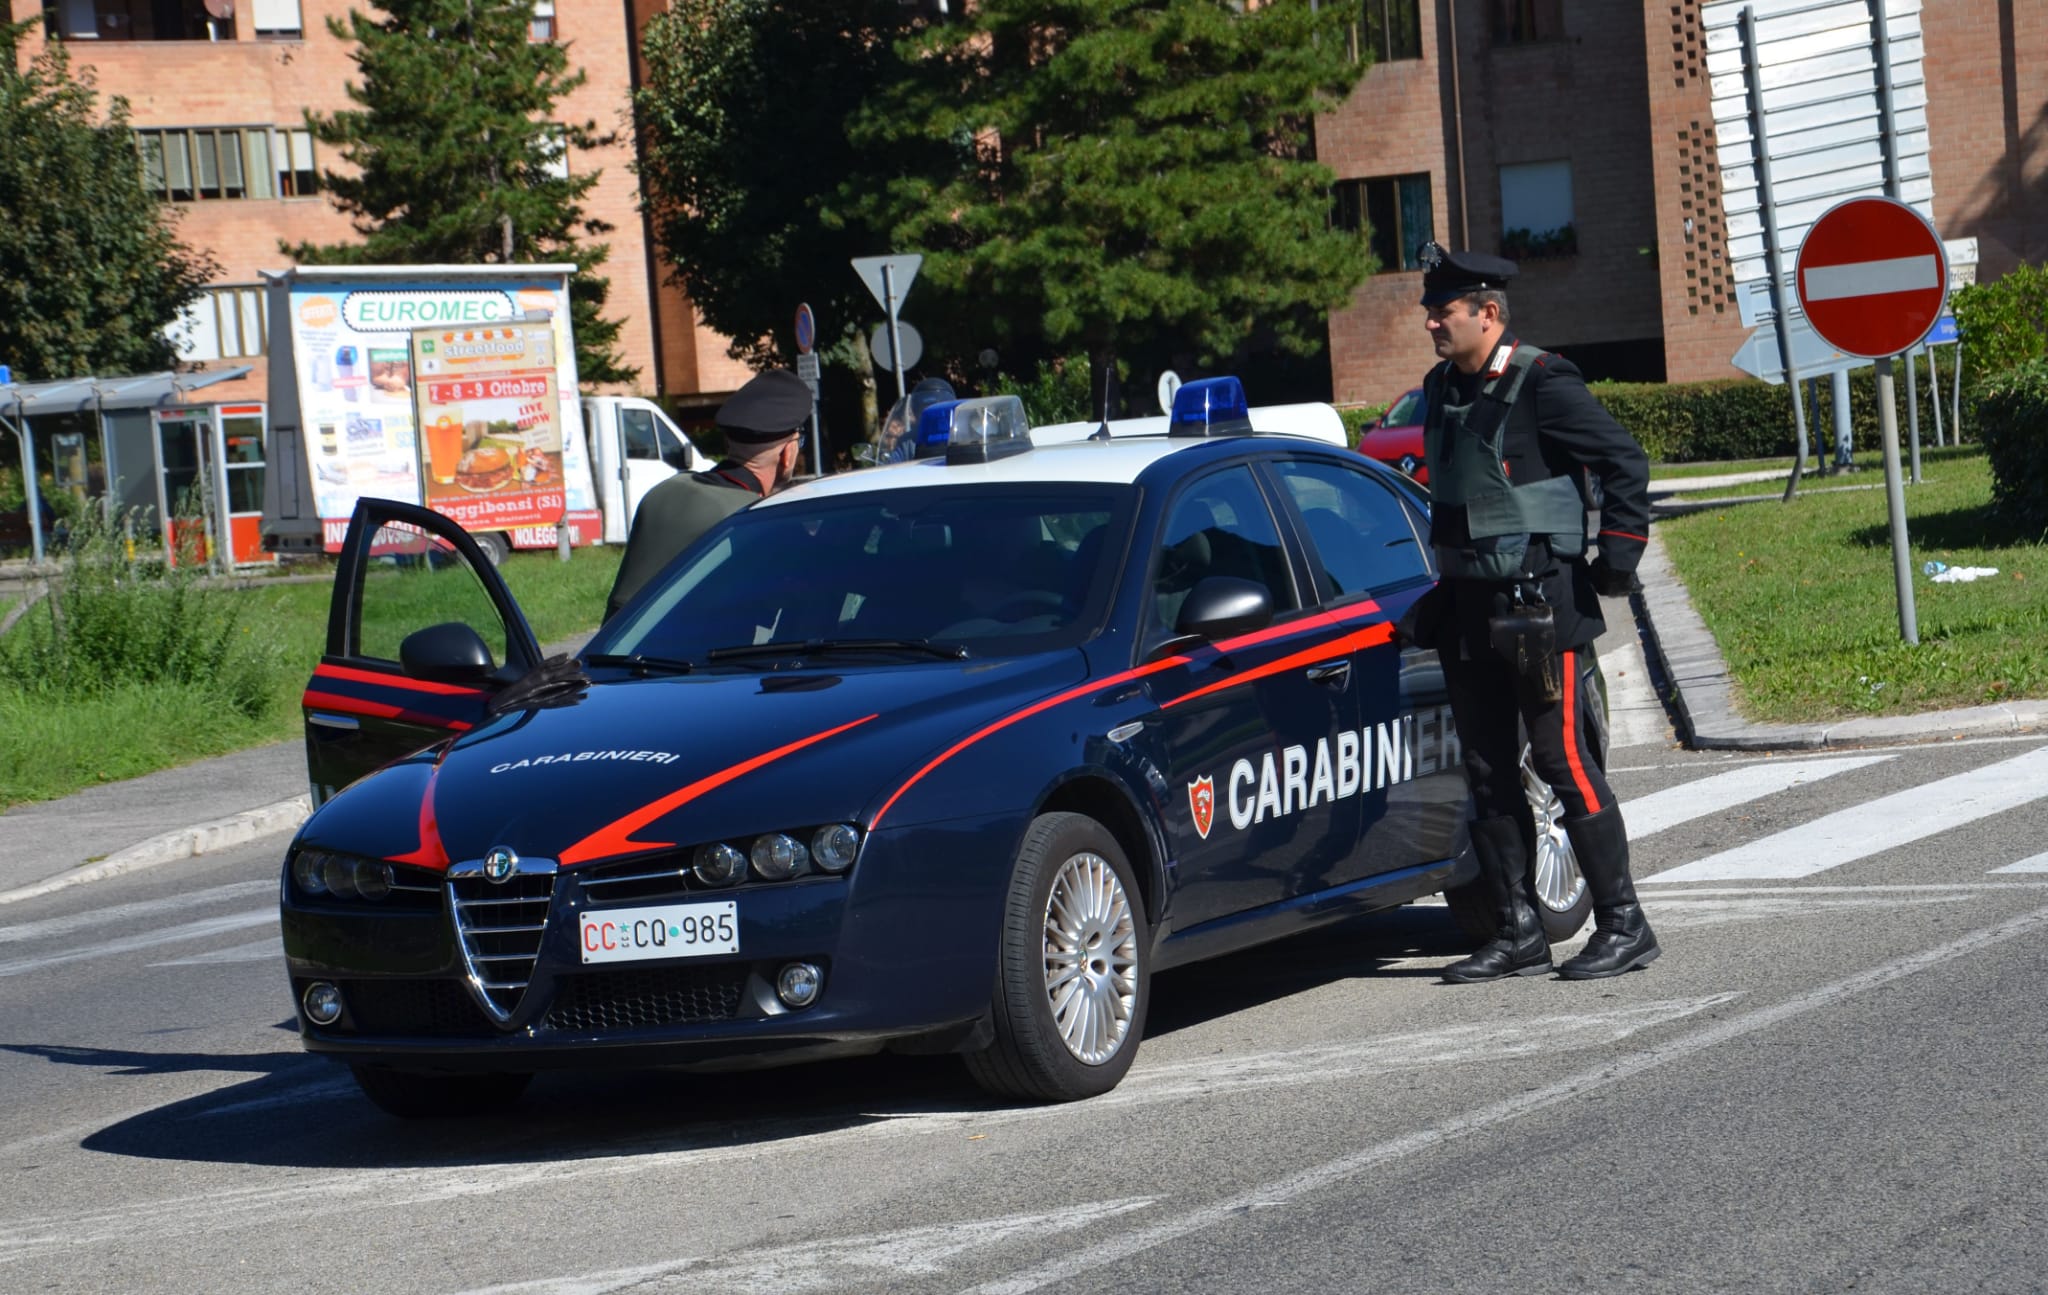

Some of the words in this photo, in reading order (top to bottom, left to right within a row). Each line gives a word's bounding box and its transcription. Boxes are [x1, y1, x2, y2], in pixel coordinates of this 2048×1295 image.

[358, 300, 500, 322] EUROMEC
[444, 341, 524, 357] streetfood
[490, 380, 546, 397] Ottobre
[518, 402, 543, 416] LIVE
[516, 412, 551, 428] SHOW
[434, 498, 532, 519] Poggibonsi
[490, 749, 681, 774] CARABINIERI
[1228, 704, 1461, 831] CARABINIER
[584, 921, 616, 952] CC
[634, 918, 667, 948] CQ
[682, 913, 733, 944] 985
